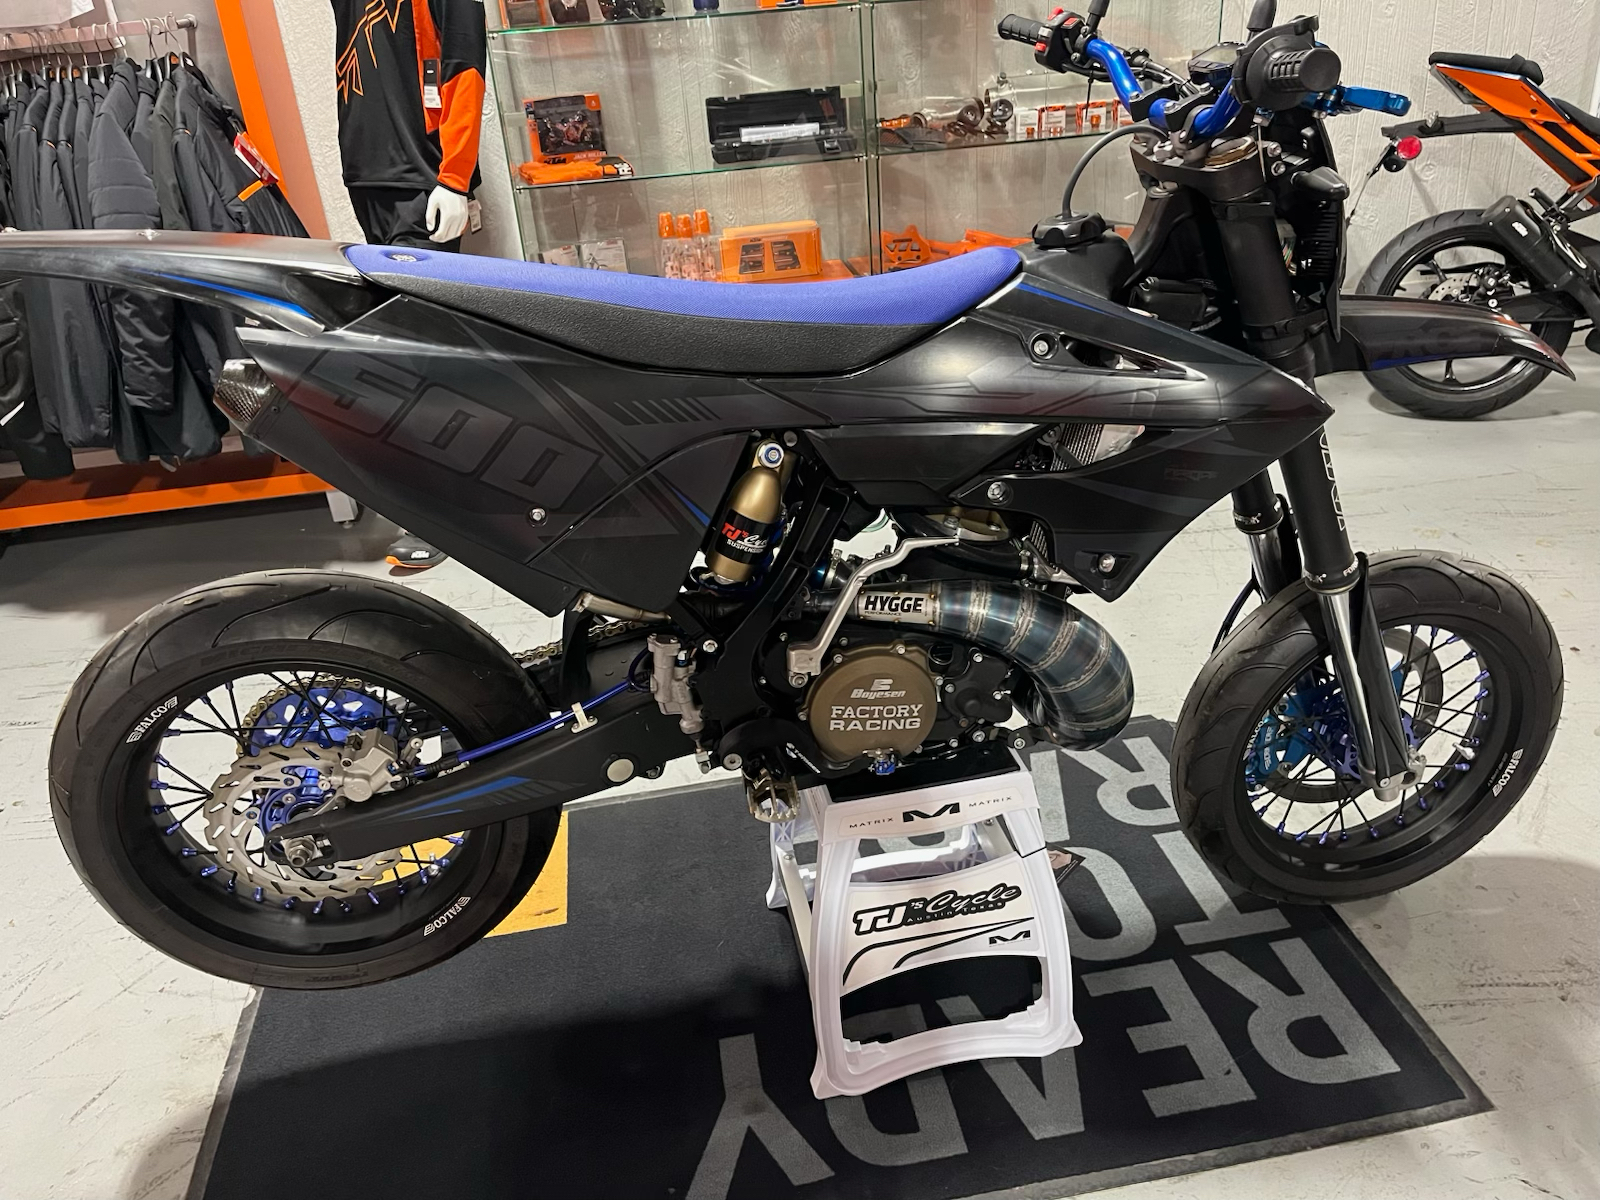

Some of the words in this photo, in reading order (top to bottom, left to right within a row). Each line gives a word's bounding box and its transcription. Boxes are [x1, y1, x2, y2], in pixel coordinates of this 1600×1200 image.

[864, 595, 925, 613] HYGGE
[850, 688, 907, 700] Boyesen
[830, 703, 923, 719] FACTORY
[829, 717, 922, 732] RACING
[849, 817, 894, 829] MATRIX
[968, 796, 1012, 807] MATRIX
[925, 885, 1022, 914] Cycle
[684, 937, 1401, 1200] READY
